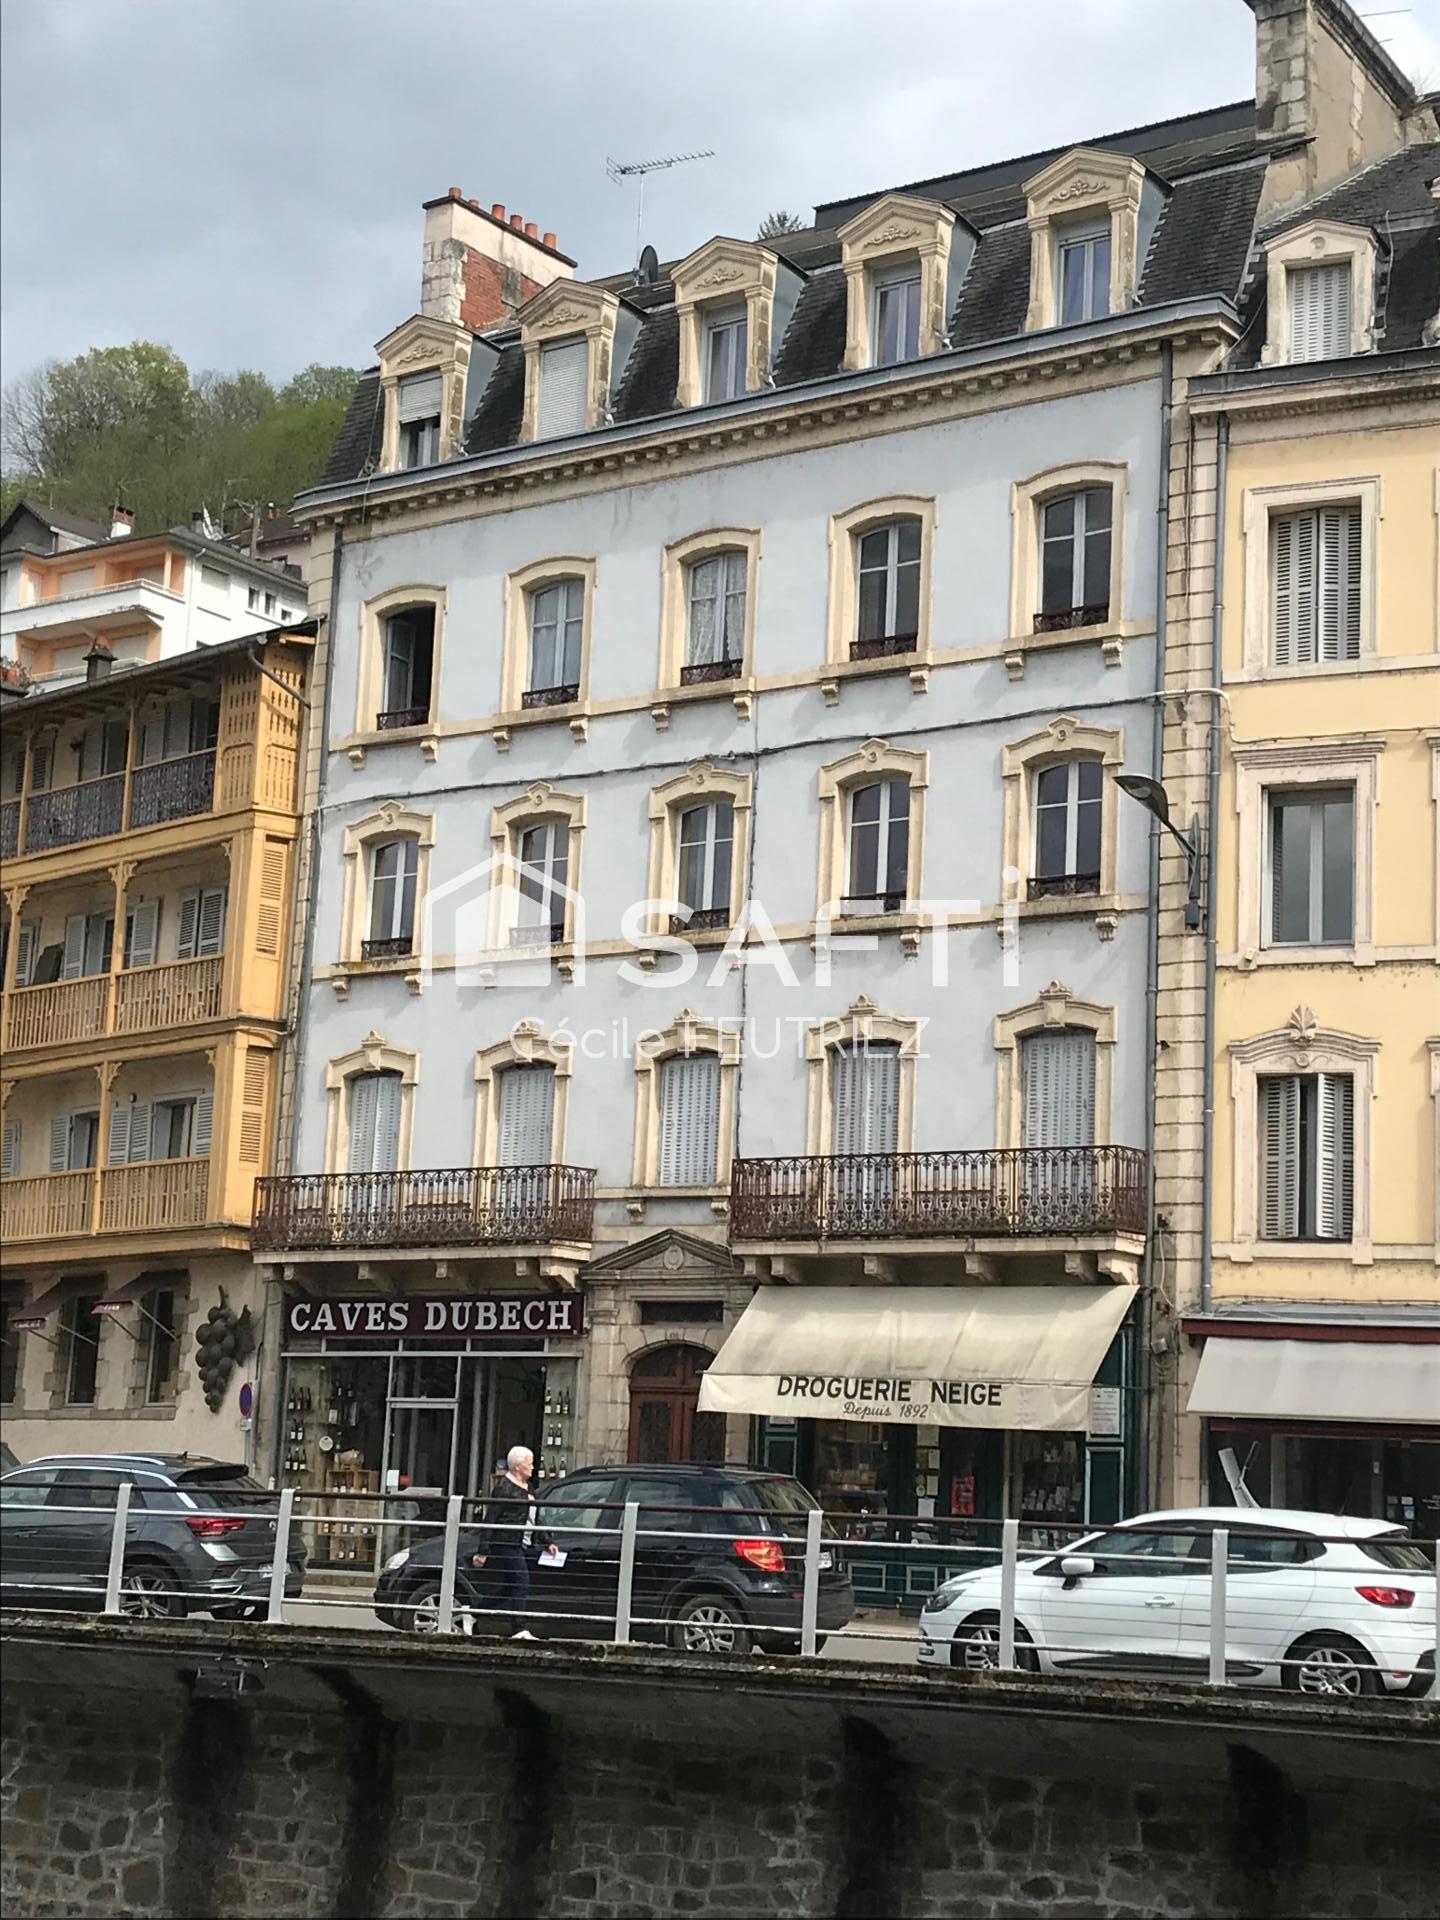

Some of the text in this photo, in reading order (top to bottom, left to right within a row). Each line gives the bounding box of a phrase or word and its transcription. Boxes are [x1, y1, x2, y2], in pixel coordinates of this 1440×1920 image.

[290, 1301, 572, 1331] CAVES DUBECH
[777, 1376, 1002, 1406] DROGUERIE NEIGE
[843, 1402, 929, 1418] Depuis 1892
